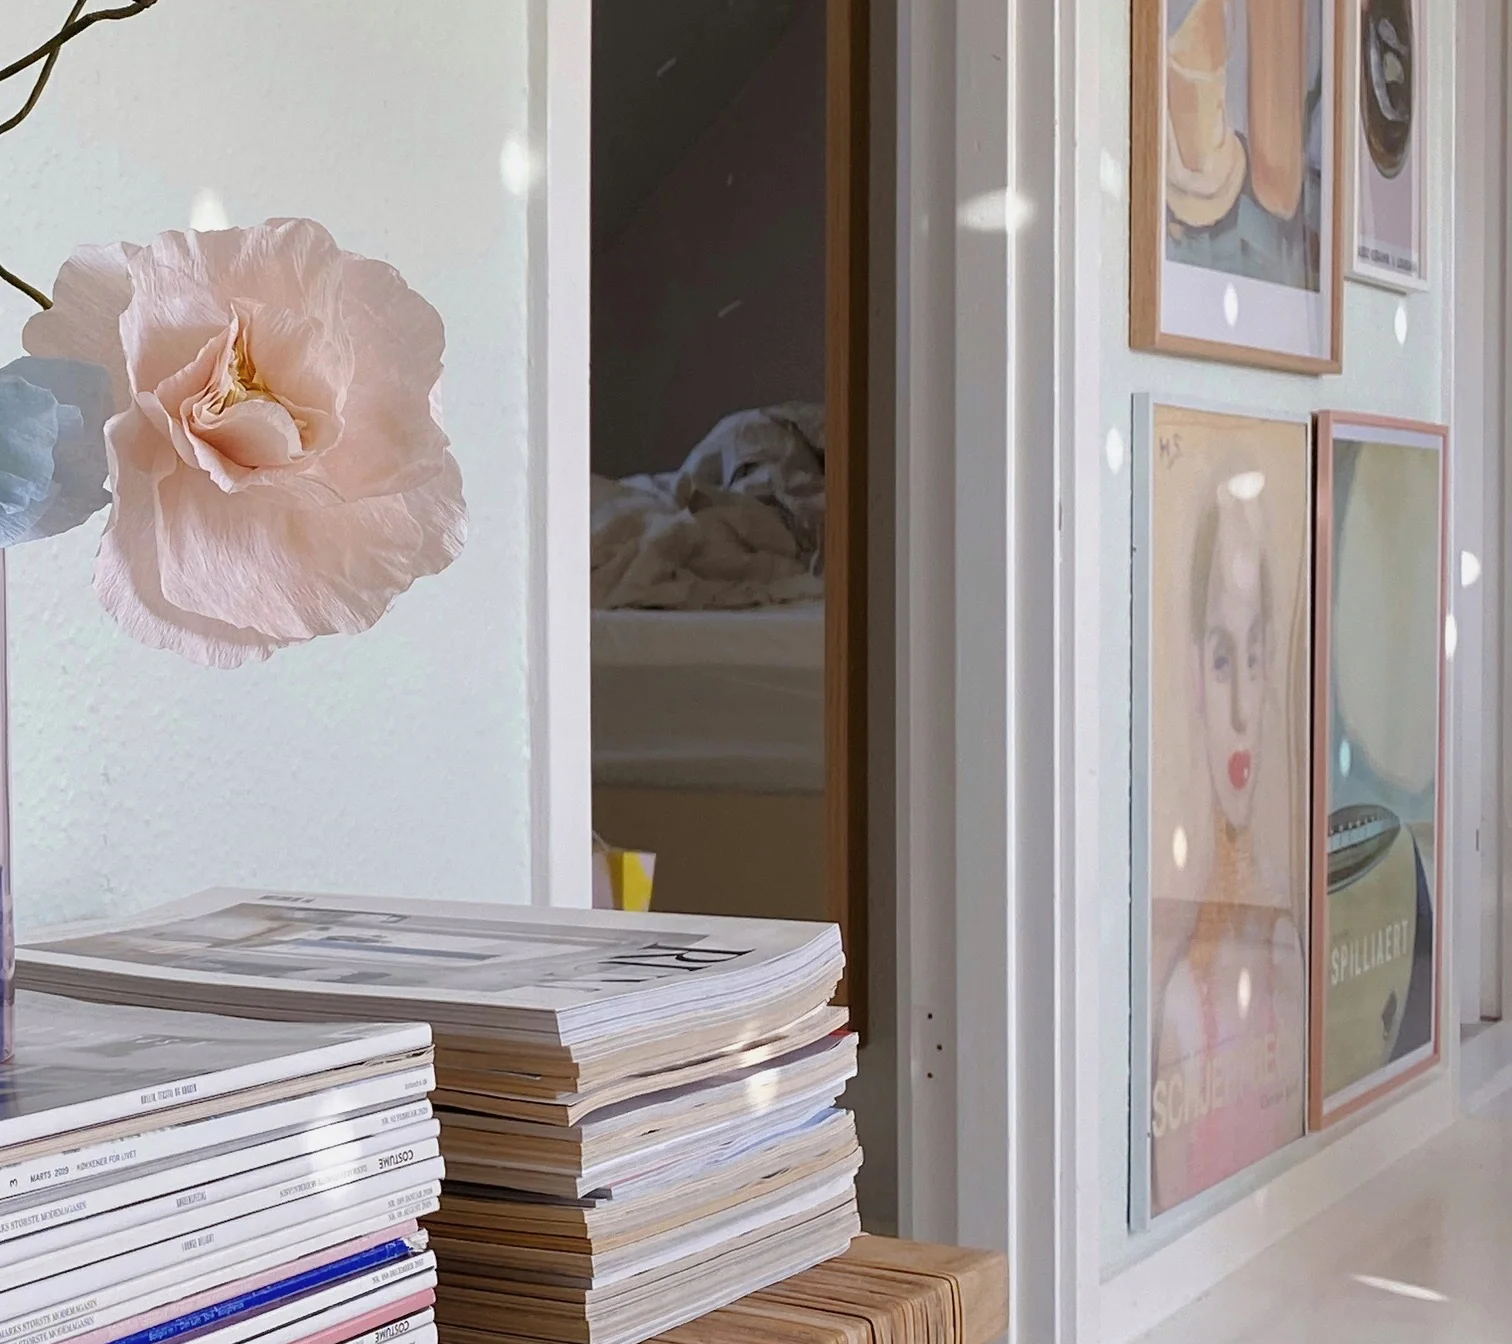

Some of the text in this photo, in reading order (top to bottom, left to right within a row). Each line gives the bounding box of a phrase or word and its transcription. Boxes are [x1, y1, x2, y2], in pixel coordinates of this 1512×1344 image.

[30, 1170, 51, 1183] MARTS
[109, 1153, 119, 1164] FOR
[121, 1148, 136, 1160] LIVET
[378, 1150, 414, 1169] COSTUME
[375, 1321, 410, 1343] COSTUME
